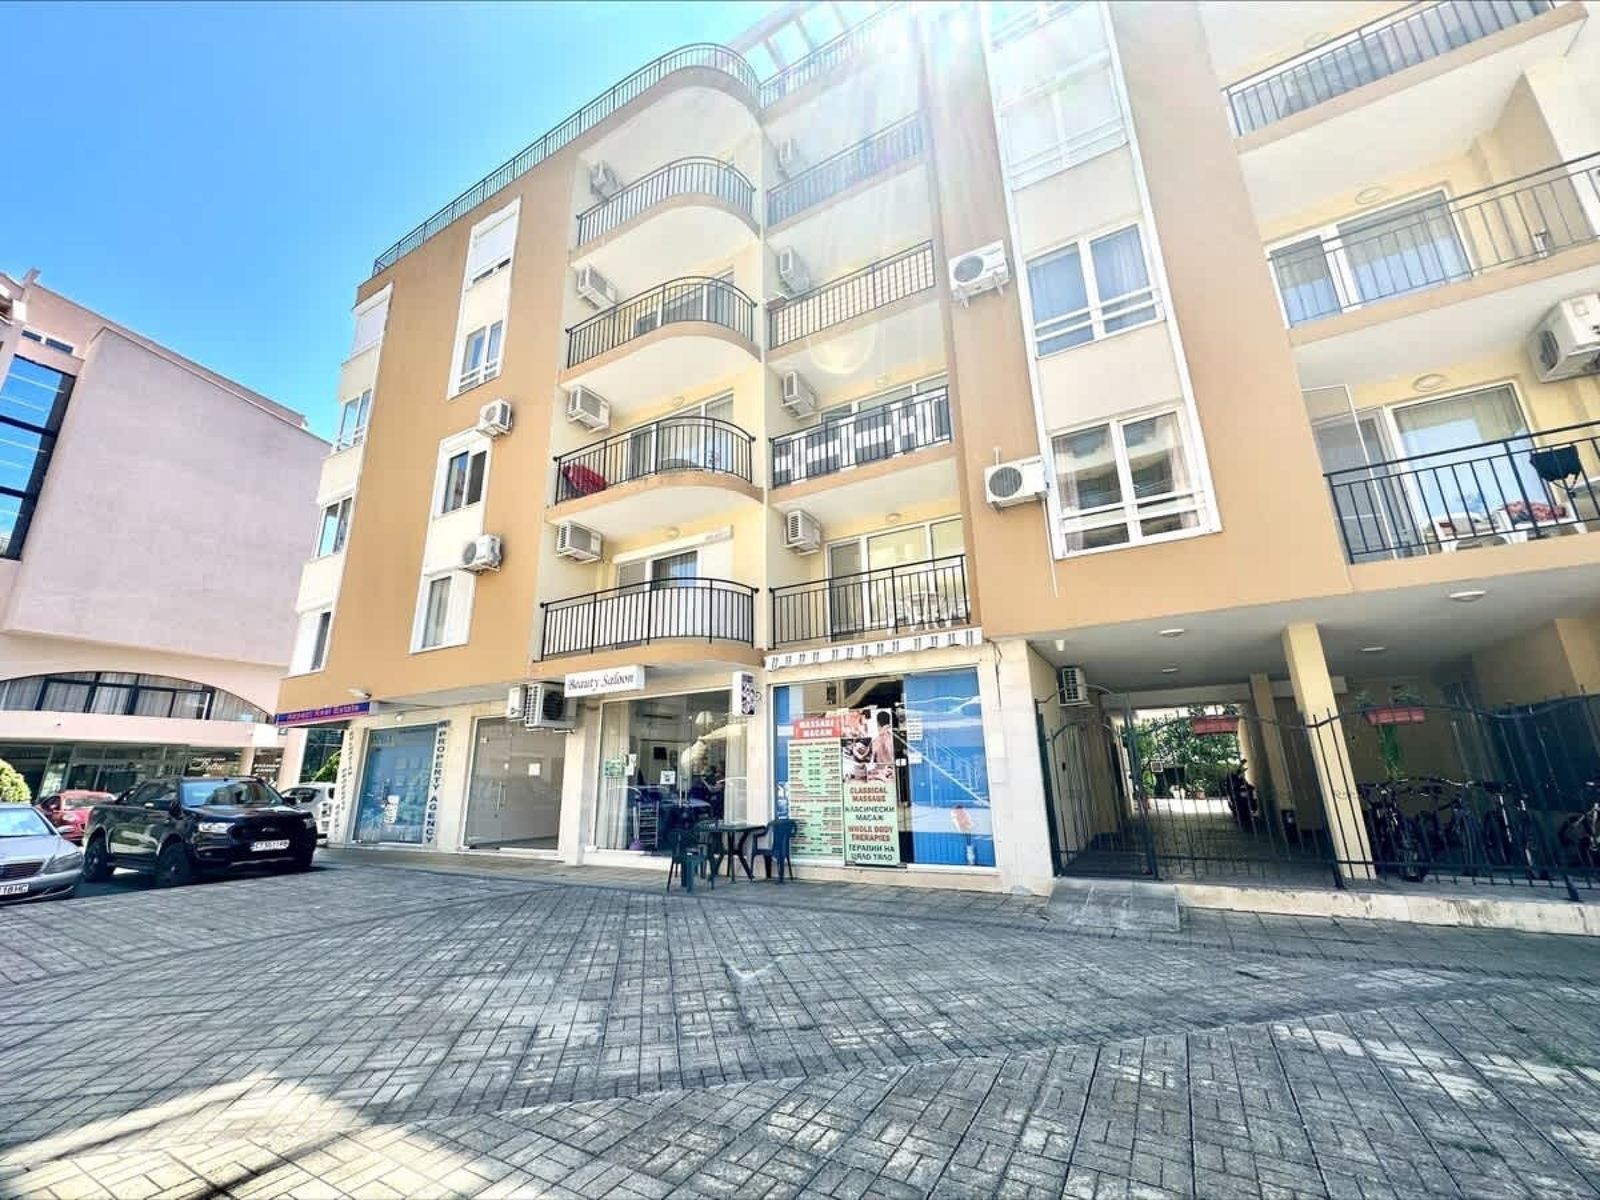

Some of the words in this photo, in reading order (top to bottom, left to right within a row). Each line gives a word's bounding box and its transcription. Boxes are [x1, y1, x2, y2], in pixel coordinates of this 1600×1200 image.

[568, 678, 600, 692] Beauty
[601, 671, 634, 688] Saloon
[850, 786, 888, 794] CLASSICAL
[425, 795, 439, 844] AGENCY
[848, 825, 872, 833] WHOLE
[874, 825, 893, 833] BODY
[851, 834, 891, 842] THERAPIES
[849, 843, 882, 852] ТЕРАПИИ
[884, 844, 895, 853] НА
